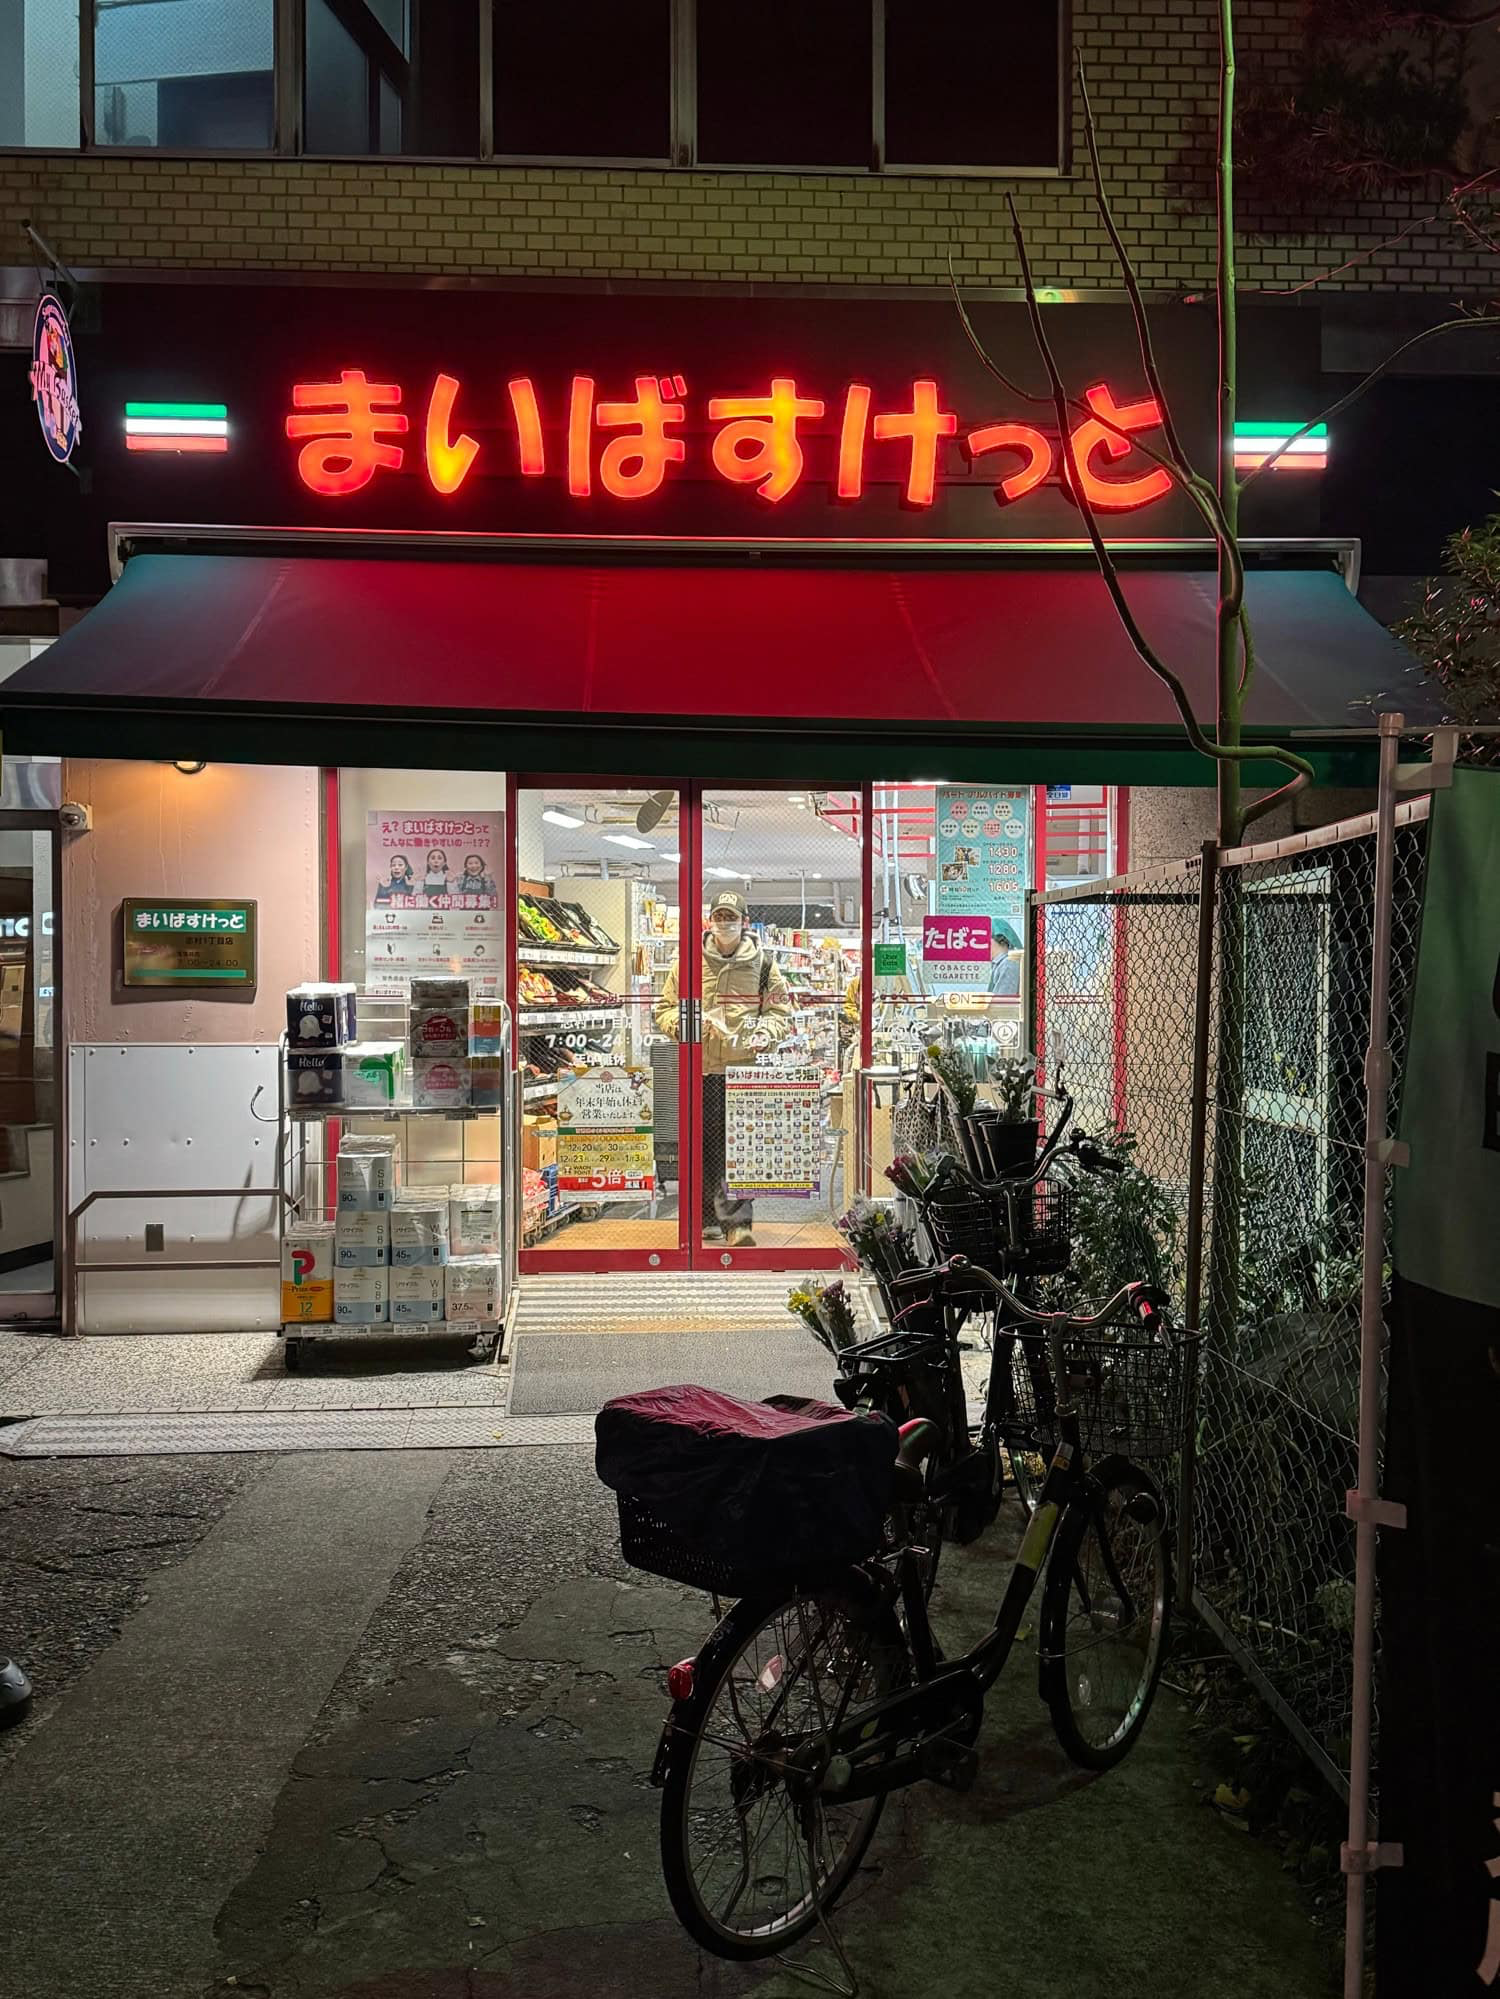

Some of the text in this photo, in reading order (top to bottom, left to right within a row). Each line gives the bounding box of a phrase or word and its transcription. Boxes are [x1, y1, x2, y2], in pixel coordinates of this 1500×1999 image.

[286, 370, 1172, 507] まいばすけっと
[136, 912, 245, 929] まいばすけっと
[925, 926, 989, 950] たばこ
[933, 964, 980, 972] TOBACCO
[933, 972, 980, 980] CIGARETTE
[299, 1001, 324, 1012] Hello
[298, 1056, 325, 1068] Hello
[377, 1168, 385, 1178] S
[592, 1166, 623, 1188] 5倍
[376, 1225, 384, 1234] S
[430, 1224, 440, 1233] W
[375, 1280, 382, 1290] S
[430, 1279, 439, 1288] W
[300, 1302, 313, 1313] 12
